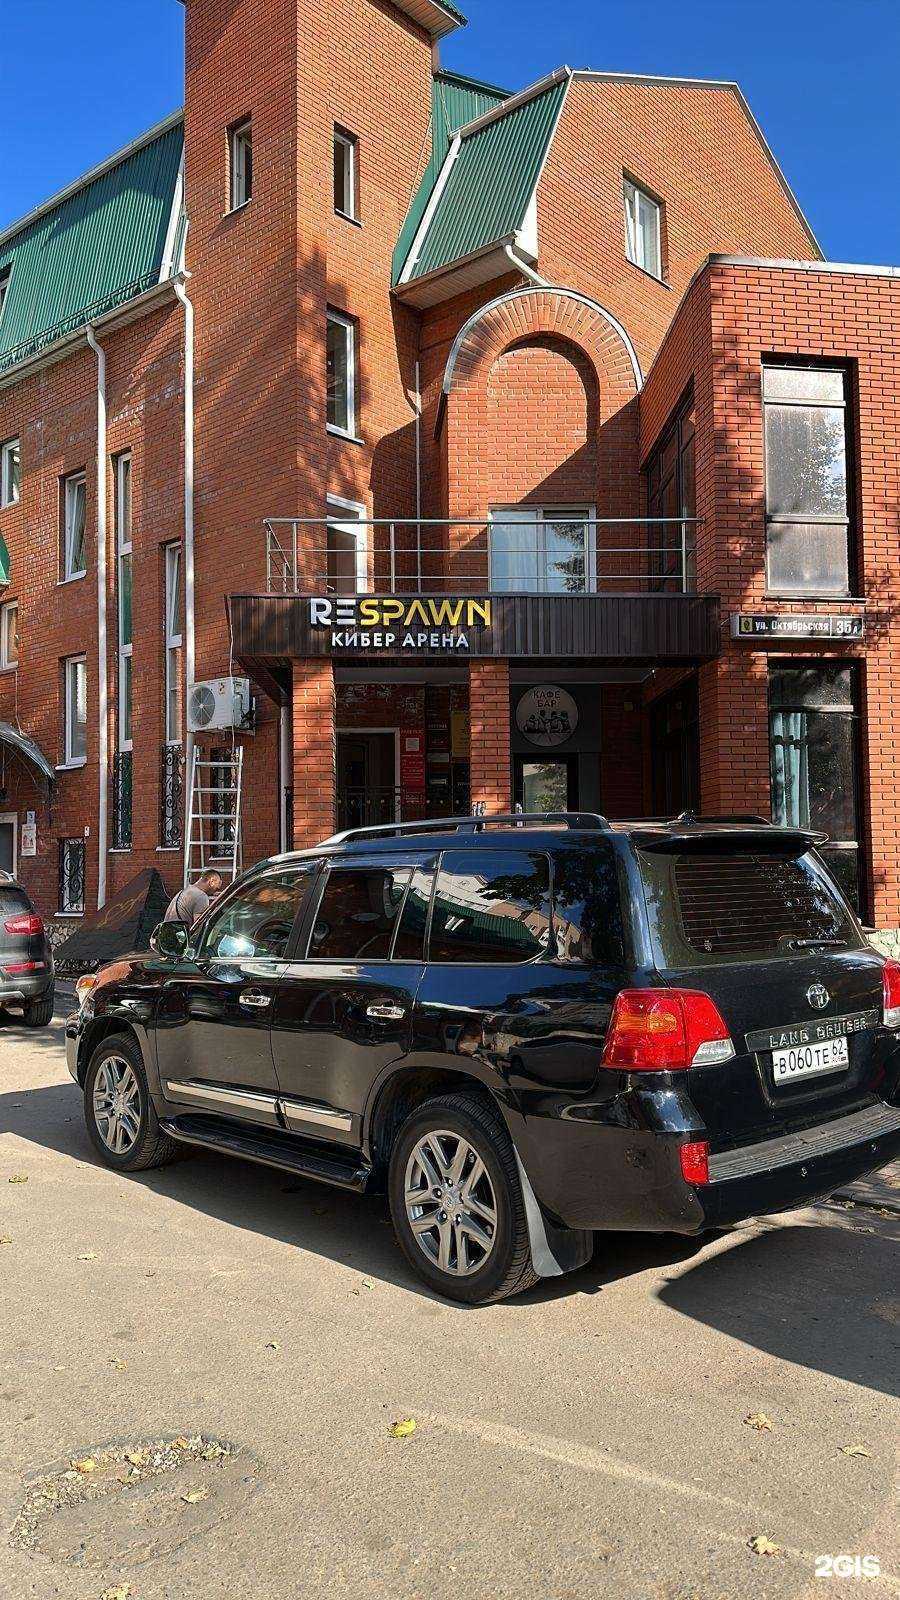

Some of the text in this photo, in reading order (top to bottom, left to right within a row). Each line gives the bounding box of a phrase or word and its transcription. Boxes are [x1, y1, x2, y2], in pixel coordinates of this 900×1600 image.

[310, 598, 492, 626] RESPAWN
[755, 620, 769, 631] ул.
[771, 620, 830, 632] Октябрьская
[331, 632, 469, 648] КИБЕР АРЕНА
[533, 690, 561, 699] КАФЕ
[537, 699, 557, 708] БАР
[769, 1018, 867, 1048] LAND CRUISER
